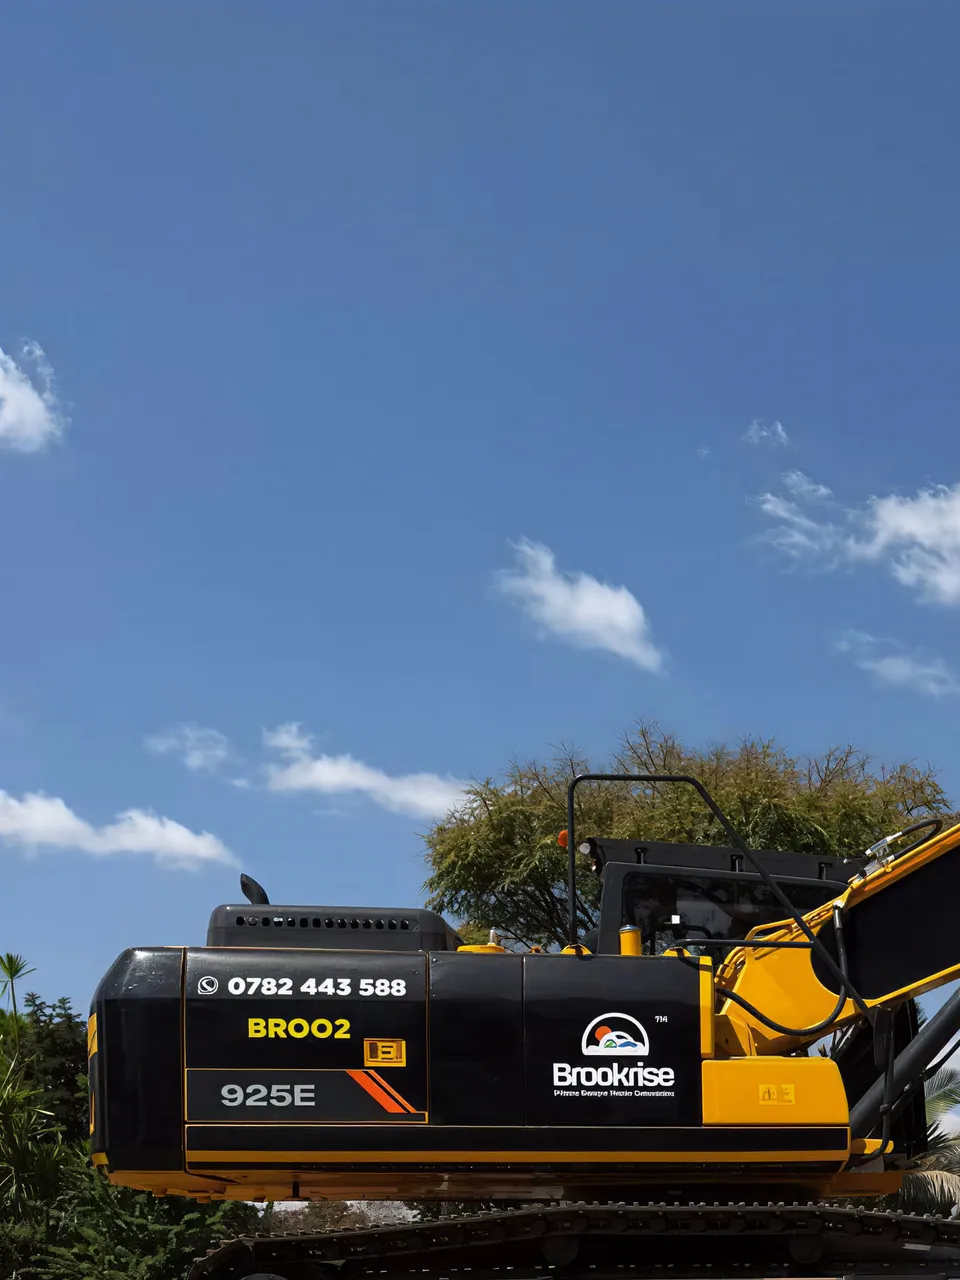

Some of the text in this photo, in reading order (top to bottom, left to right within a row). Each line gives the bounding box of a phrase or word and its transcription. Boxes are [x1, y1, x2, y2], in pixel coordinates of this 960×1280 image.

[227, 977, 407, 996] 0782 443 588
[552, 1061, 675, 1087] Brookrise
[220, 1084, 316, 1107] 925E
